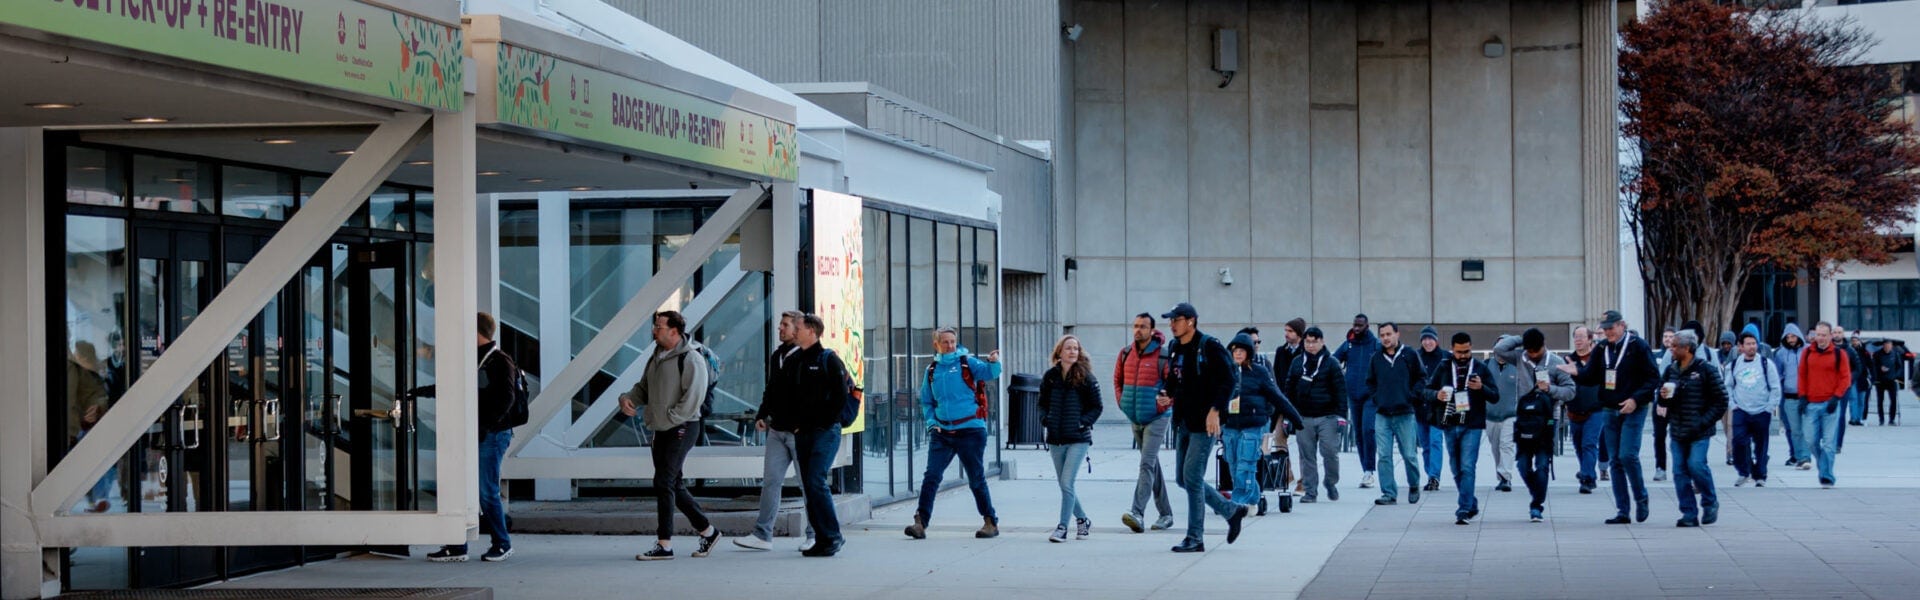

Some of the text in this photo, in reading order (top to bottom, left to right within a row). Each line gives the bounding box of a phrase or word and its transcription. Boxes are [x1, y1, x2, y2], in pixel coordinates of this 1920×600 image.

[106, 0, 192, 29] CK-UP
[213, 0, 303, 54] RE-ENTRY
[612, 92, 644, 132] BADGE
[646, 101, 680, 139] PICK-UP
[688, 112, 726, 150] RE-ENTRY
